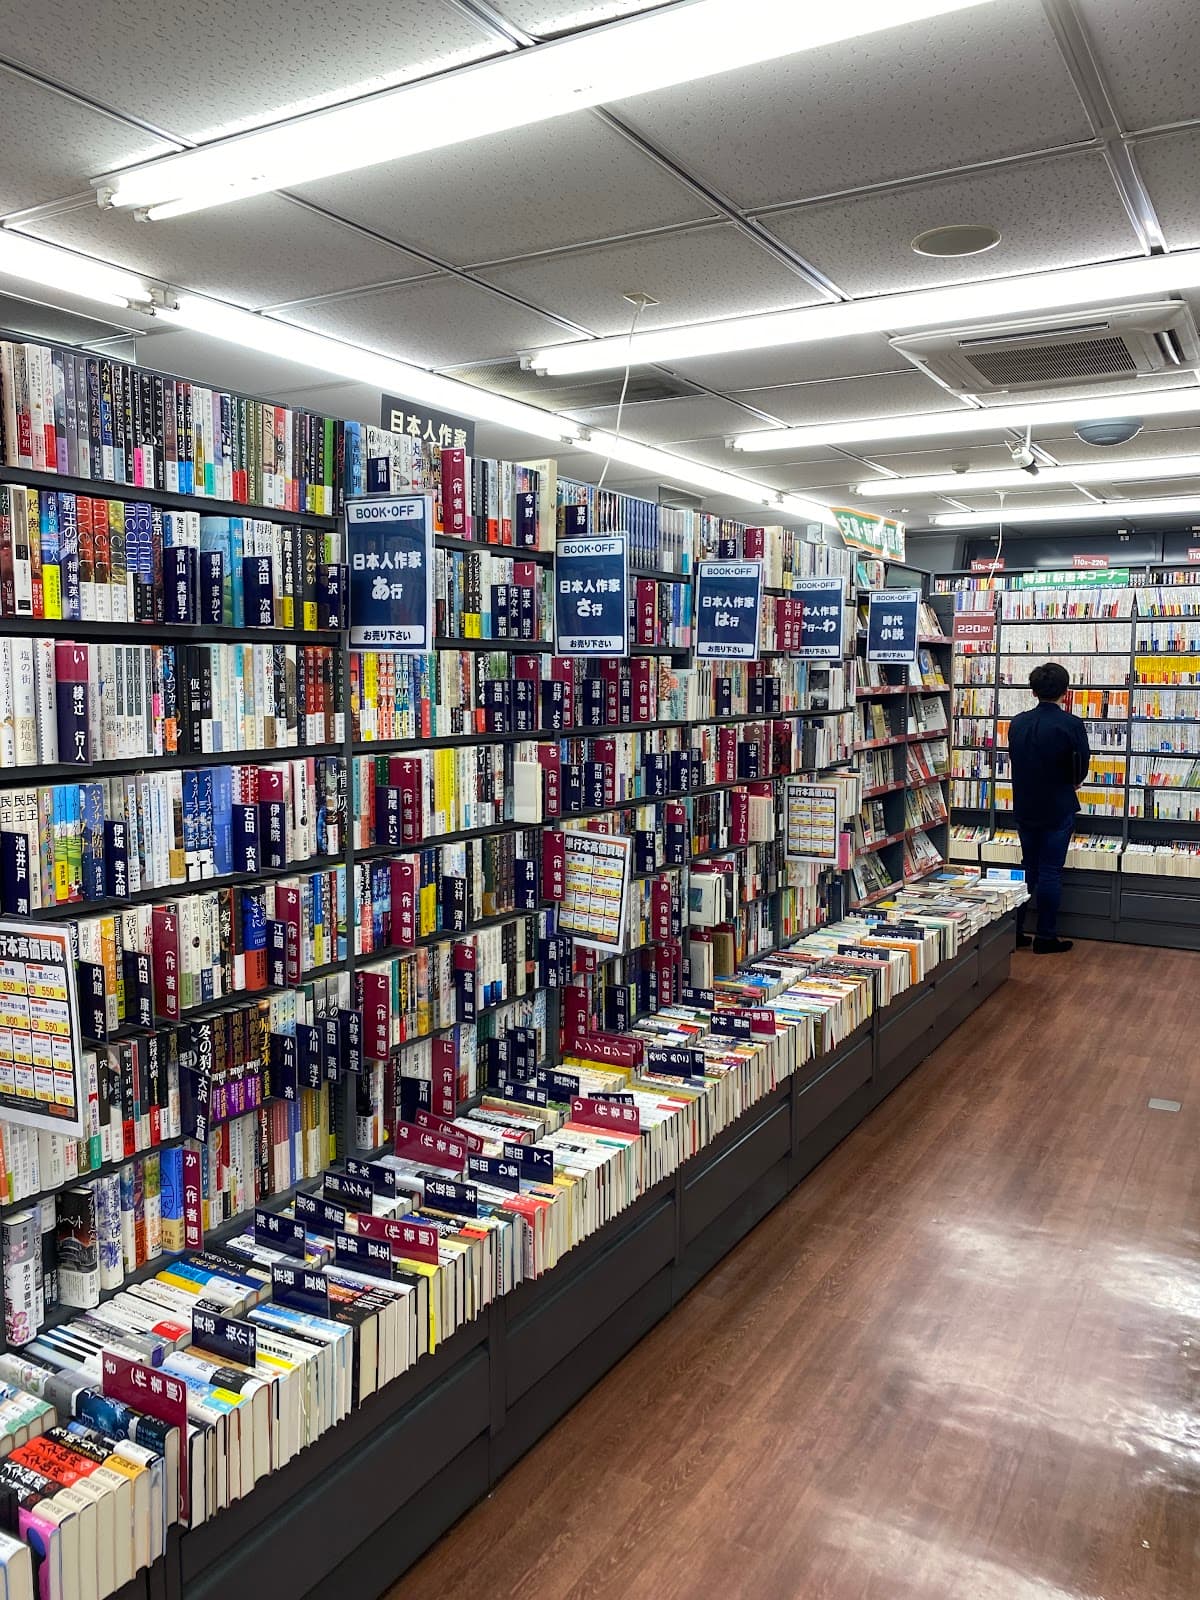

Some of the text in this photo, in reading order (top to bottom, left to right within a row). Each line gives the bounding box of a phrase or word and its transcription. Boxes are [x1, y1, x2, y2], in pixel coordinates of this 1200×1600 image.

[390, 409, 467, 449] 日本人作家
[454, 452, 462, 463] こ
[152, 510, 162, 535] 東京
[576, 507, 586, 525] 東野
[353, 551, 422, 571] 日本人作家
[175, 549, 188, 621] 青山 美智子
[211, 553, 222, 622] 朝井 まかて
[257, 558, 271, 625] 浅田 次郎
[372, 576, 403, 600] あ行
[560, 579, 621, 594] 日本人作家
[327, 566, 339, 627] 芦沢 央
[522, 588, 531, 609] 笹本
[702, 597, 755, 609] 日本人作家
[576, 599, 603, 617] さ行
[802, 606, 839, 616] 本人作家
[715, 612, 740, 627] は行
[882, 615, 903, 626] 時代
[363, 630, 412, 642] お売り下さい
[569, 638, 612, 649] お売り下さい
[880, 629, 905, 641] 小説
[74, 650, 85, 664] い
[707, 646, 744, 654] お売り下さい
[20, 650, 31, 685] 塩の街
[494, 682, 503, 702] 塩田
[517, 681, 526, 701] 島本
[72, 685, 86, 761] 綾辻 行人
[402, 762, 412, 774] そ
[270, 774, 280, 788] う
[1, 795, 12, 823] 民王
[14, 794, 25, 822] 民王
[26, 793, 37, 821] 民王
[270, 803, 281, 842] 伊集院
[243, 807, 257, 872] 石田 衣良
[15, 835, 26, 882] 池井戸
[113, 823, 126, 897] 伊坂 幸太郎
[401, 866, 411, 876] つ
[287, 892, 297, 905] お
[454, 879, 463, 901] 辻村
[164, 917, 174, 932] え
[138, 956, 150, 1026] 内田 康夫
[377, 977, 386, 989] と
[92, 968, 104, 1038] 内館 牧子
[349, 1013, 359, 1045] 小野寺
[283, 1038, 294, 1067] 小川
[308, 1029, 319, 1087] 小川 洋子
[574, 1040, 631, 1057] アンソロジー
[195, 1077, 208, 1142] 大沢 在昌
[574, 1101, 584, 1111] ひ
[185, 1154, 197, 1168] か
[469, 1157, 489, 1172] 原田
[504, 1144, 552, 1166] 原田 マハ
[348, 1161, 370, 1178] 神永
[342, 1182, 372, 1200] シゲアキ
[426, 1182, 476, 1203] 久坂部 羊
[255, 1212, 279, 1233] 海堂
[360, 1221, 372, 1232] く
[336, 1234, 391, 1261] 桐野 夏生
[273, 1267, 295, 1286] 京極
[194, 1315, 248, 1345] 貴志 祐介
[104, 1361, 117, 1375] き
